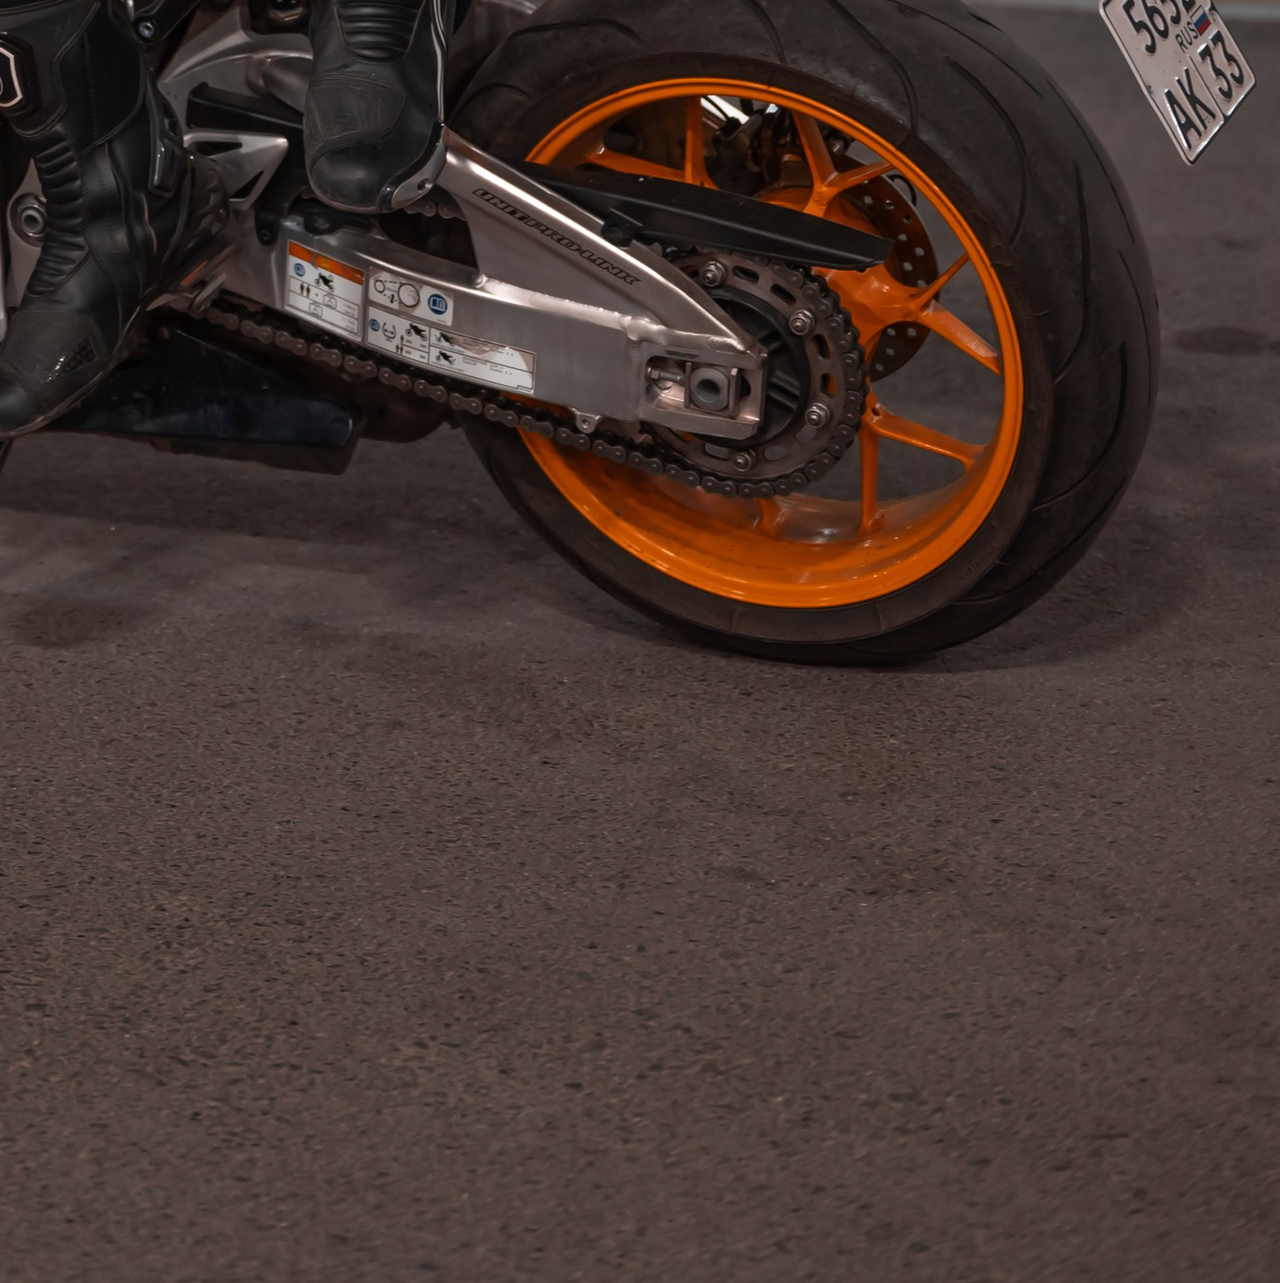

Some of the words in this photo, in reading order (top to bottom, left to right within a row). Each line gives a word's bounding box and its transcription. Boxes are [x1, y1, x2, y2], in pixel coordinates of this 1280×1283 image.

[1175, 20, 1199, 54] RUS
[1164, 66, 1216, 151] AK
[1197, 29, 1245, 100] 33
[472, 188, 530, 223] UNIT
[526, 218, 642, 286] PRO-LINK
